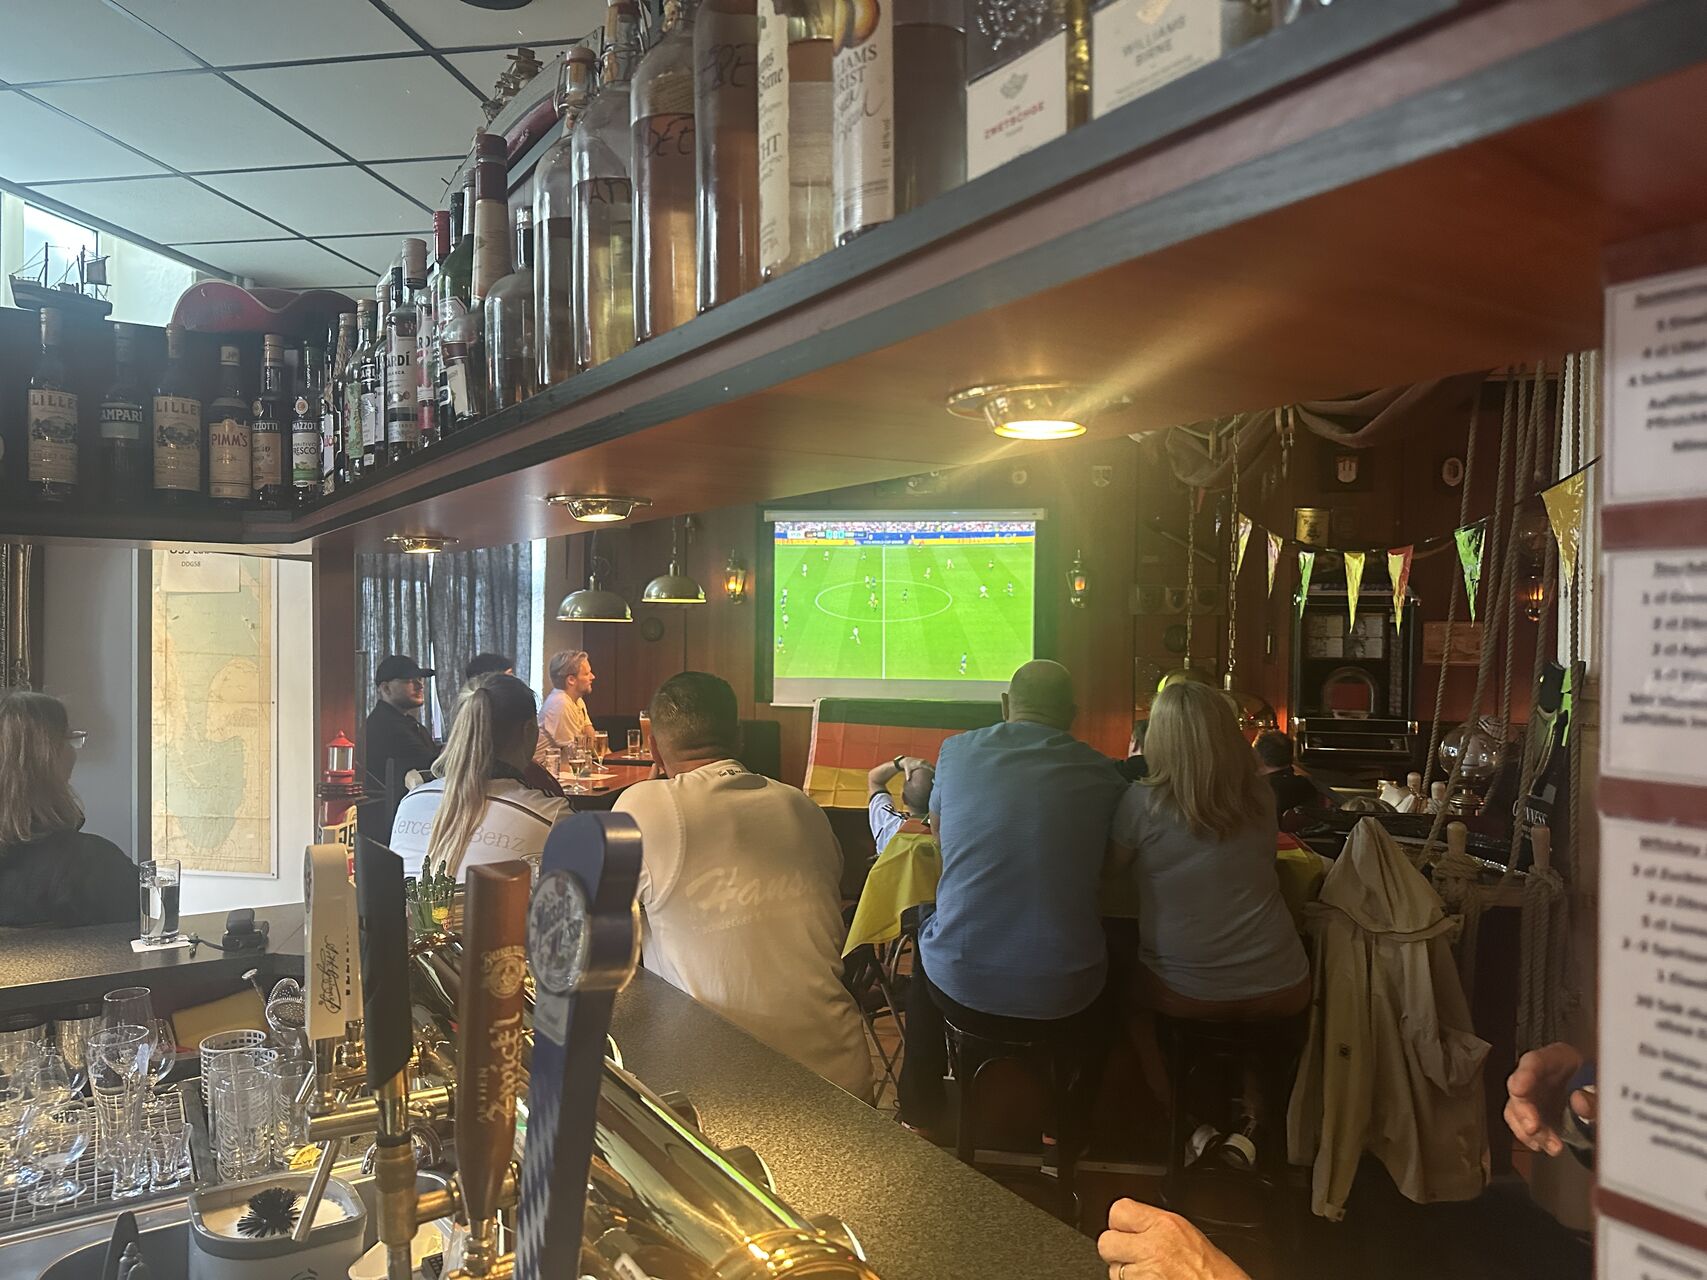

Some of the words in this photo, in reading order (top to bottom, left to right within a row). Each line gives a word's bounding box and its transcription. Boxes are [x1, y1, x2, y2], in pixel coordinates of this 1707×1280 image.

[32, 393, 74, 408] LILLE
[102, 407, 143, 422] AMPARI
[252, 422, 278, 431] AZZOTTI
[211, 432, 248, 448] PIMM'S
